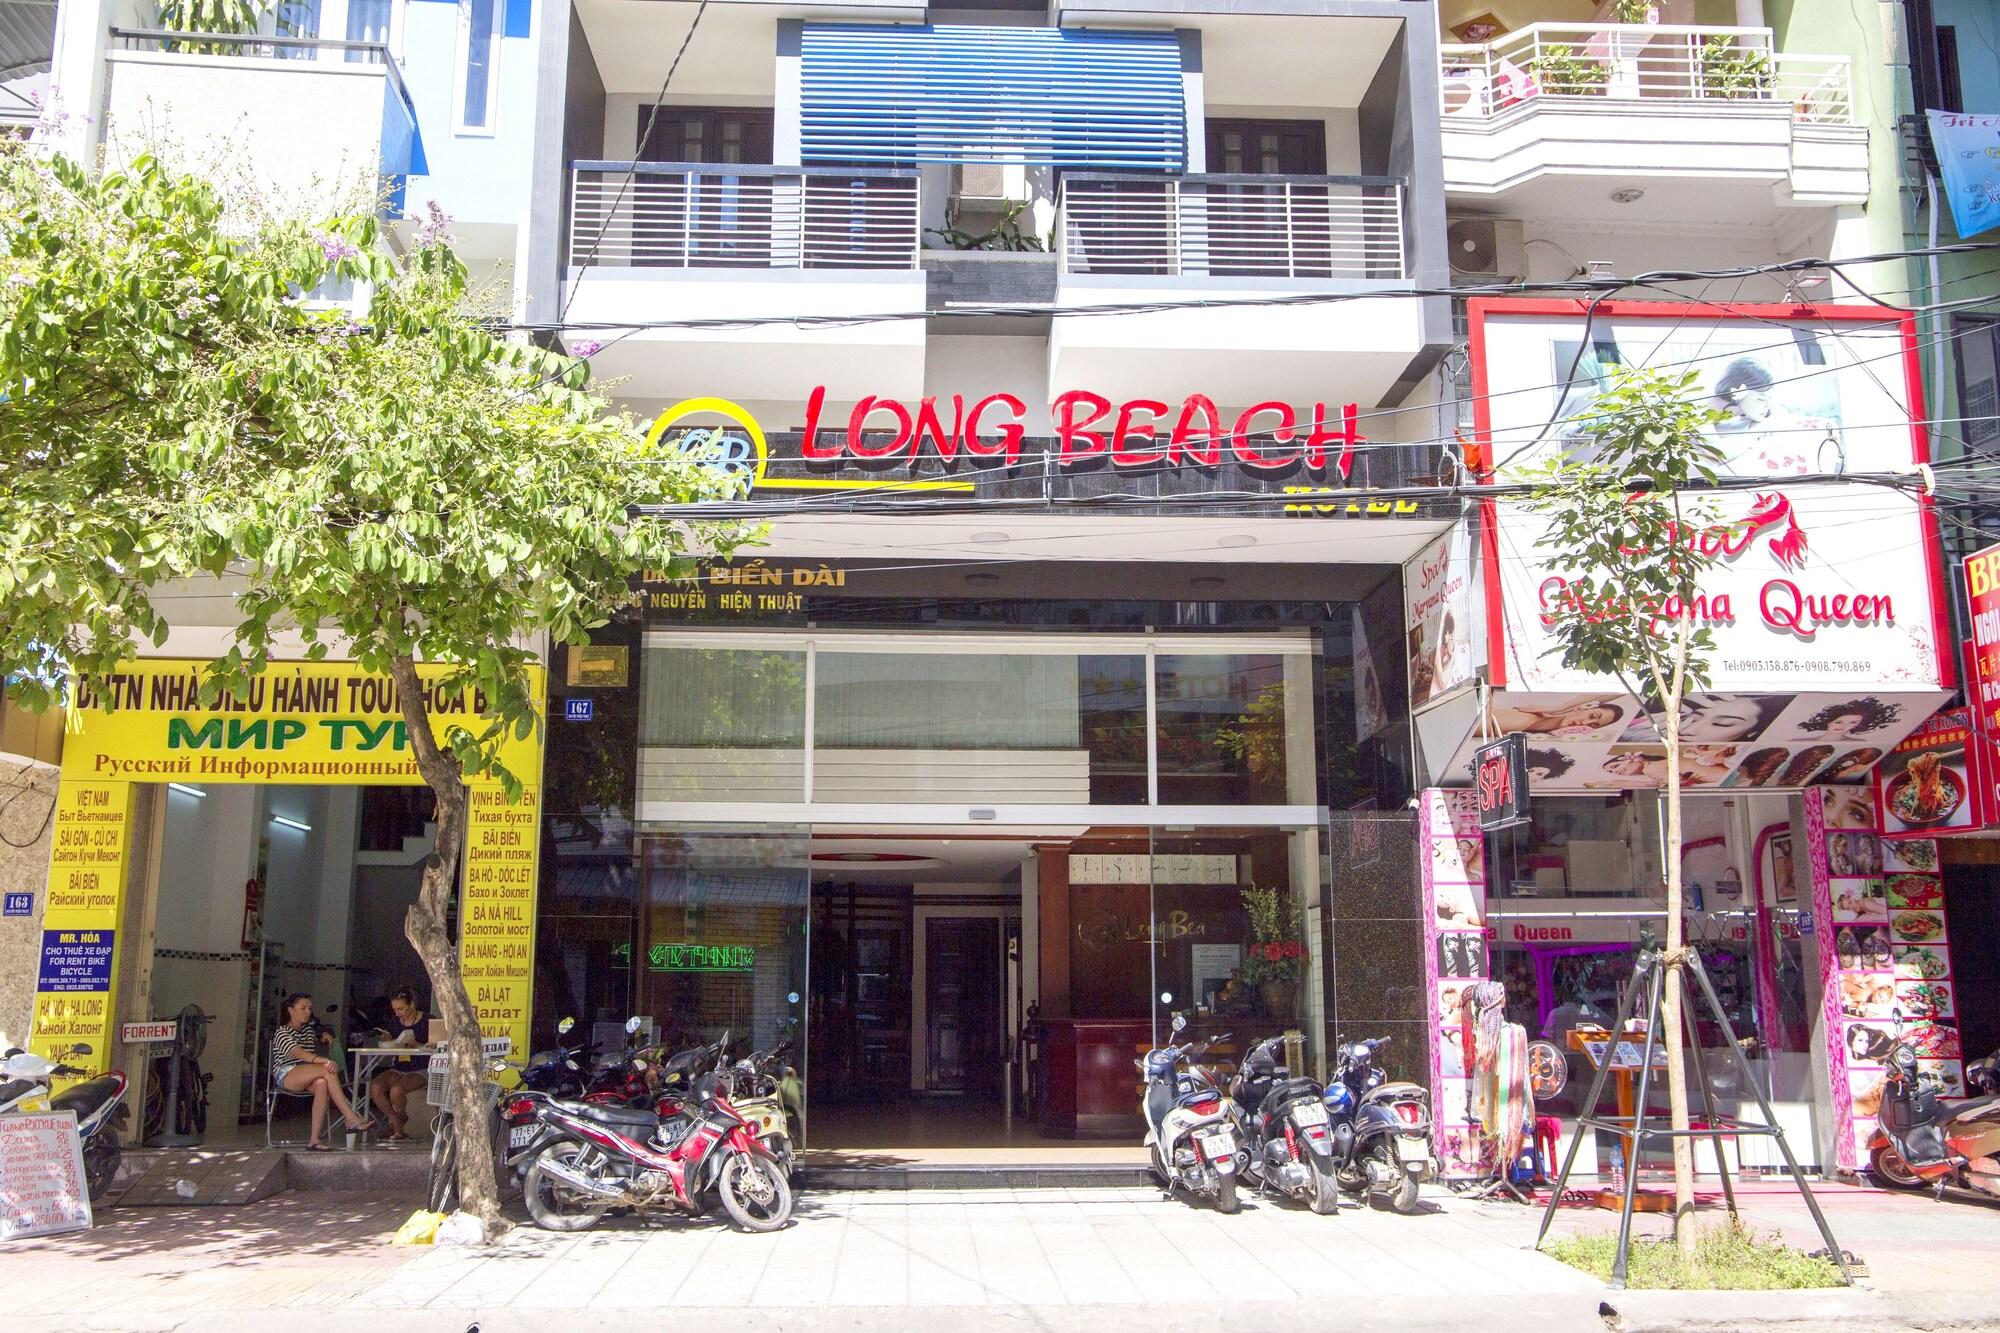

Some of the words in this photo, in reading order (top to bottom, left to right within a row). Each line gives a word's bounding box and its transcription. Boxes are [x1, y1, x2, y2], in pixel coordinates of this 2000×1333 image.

[802, 385, 1027, 465] LONG
[1052, 389, 1367, 480] BEACH
[793, 564, 846, 587] DÀI
[1421, 559, 1440, 590] Spa
[1440, 575, 1463, 603] Queen
[758, 591, 802, 614] THUẬT
[1759, 579, 1895, 636] Queen
[150, 666, 200, 711] NHÀ
[272, 667, 339, 713] HÀNH
[570, 703, 588, 713] 167
[168, 718, 305, 750] МИР
[94, 754, 190, 776] Русский
[200, 756, 417, 778] Информационный
[1479, 756, 1513, 811] SPA
[77, 790, 93, 809] VIỆT
[94, 791, 109, 806] NAM
[494, 788, 509, 806] BÌN
[60, 810, 75, 821] Быт
[77, 810, 123, 822] Вьетнамцев
[474, 810, 502, 822] Тихая
[505, 810, 532, 826] бухта
[106, 830, 117, 846] CHI
[53, 849, 77, 862] Сайгон
[79, 849, 96, 865] Кучи
[97, 849, 120, 862] Меконг
[470, 847, 501, 861] Дикий
[505, 850, 532, 860] пляж
[469, 868, 480, 883] BA
[469, 885, 490, 898] Бахо
[492, 889, 498, 898] и
[500, 886, 530, 898] Зоклет
[9, 896, 28, 909] 163
[49, 892, 85, 905] Райский
[87, 895, 116, 909] уголок
[474, 903, 486, 920] BÀ
[488, 902, 501, 920] NÀ
[504, 906, 522, 920] HILL
[465, 922, 504, 935] Золотой
[507, 925, 529, 935] мост
[1514, 923, 1573, 941] Queen
[60, 933, 78, 943] MR.
[45, 947, 62, 955] CHO
[64, 945, 84, 956] THUÊ
[85, 947, 95, 955] XE
[96, 947, 112, 957] ĐẠP
[517, 944, 527, 959] AN
[49, 957, 65, 966] FOR
[66, 957, 87, 966] RENT
[88, 957, 106, 966] BIKE
[60, 967, 92, 976] BICYCLE
[463, 965, 485, 978] Дананг
[506, 964, 528, 977] Мишон
[478, 984, 491, 1002] ĐÀ
[493, 988, 511, 1006] LẠT
[82, 999, 103, 1017] LONG
[36, 1020, 66, 1035] Ханой
[68, 1020, 103, 1035] Халонг
